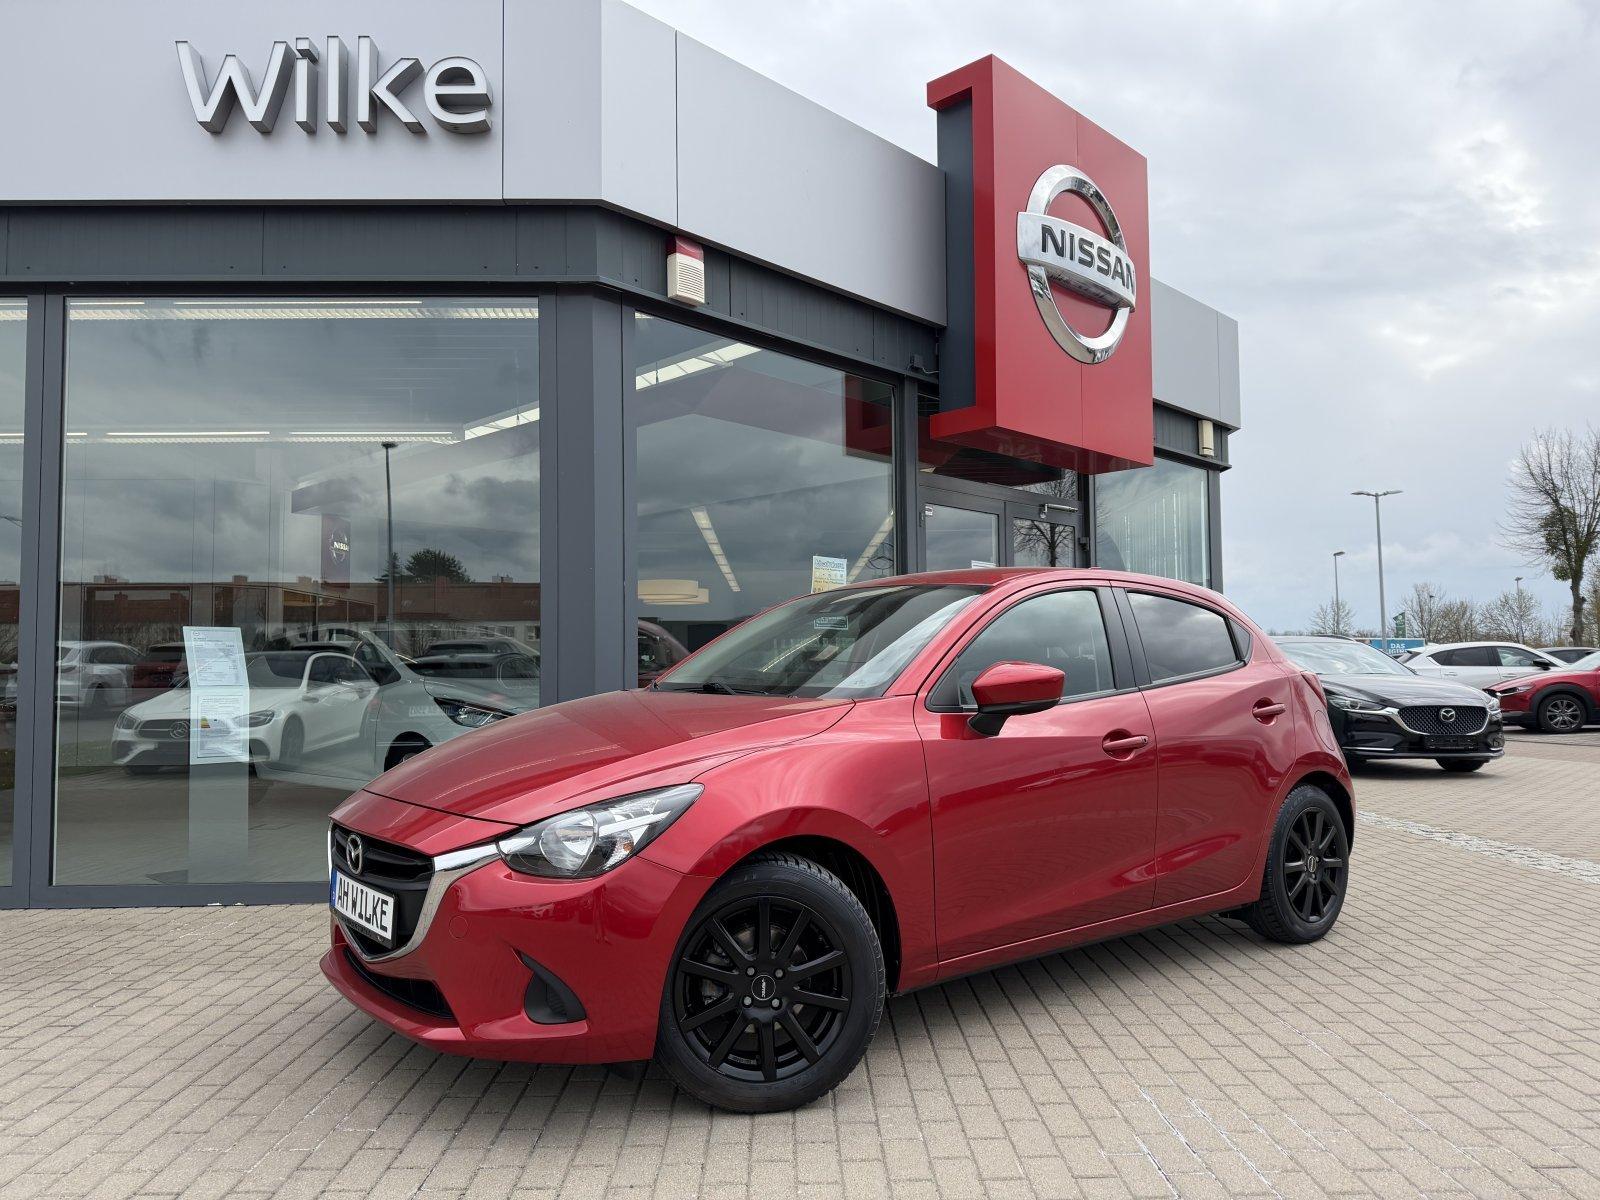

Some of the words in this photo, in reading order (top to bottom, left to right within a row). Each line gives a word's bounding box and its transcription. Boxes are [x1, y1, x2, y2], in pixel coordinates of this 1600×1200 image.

[175, 36, 493, 133] Wilke
[1041, 224, 1135, 295] NISSAN
[337, 878, 350, 911] AH
[351, 884, 389, 933] WILKE
